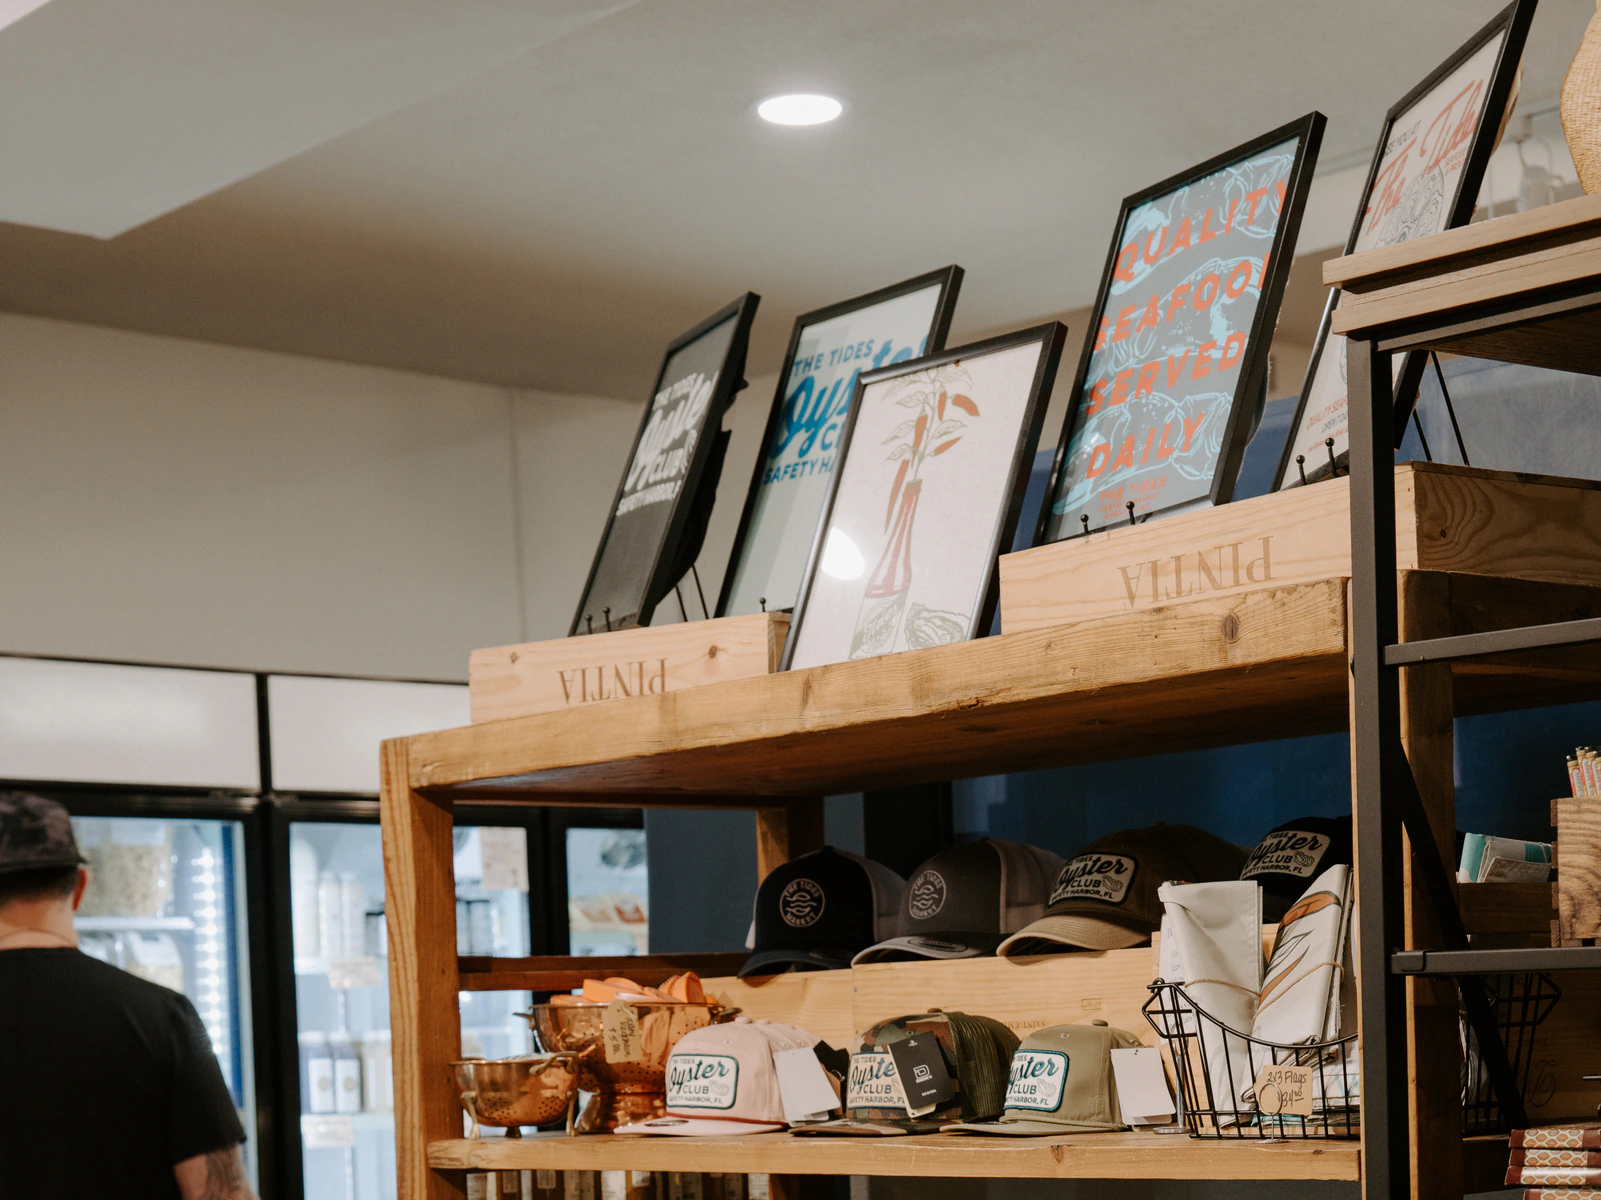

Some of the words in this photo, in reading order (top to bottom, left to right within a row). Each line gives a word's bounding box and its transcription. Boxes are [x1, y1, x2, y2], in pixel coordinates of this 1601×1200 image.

[793, 352, 825, 377] THE
[829, 339, 875, 367] TIDES
[1085, 331, 1247, 416] SERVED
[1085, 412, 1207, 479] DAILY
[764, 457, 819, 484] SAFETY
[1100, 486, 1145, 504] THE
[1129, 475, 1168, 496] TIDES
[1116, 536, 1276, 609] PINTIA
[557, 658, 669, 704] PINTIA
[1261, 854, 1294, 865] CLUB
[1070, 878, 1102, 889] CLUB
[1103, 891, 1114, 899] FL
[669, 1060, 730, 1094] Oyster
[850, 1057, 897, 1094] Oyste
[863, 1084, 892, 1094] CLUB
[1008, 1056, 1059, 1095] yster
[1013, 1083, 1037, 1095] CLUB
[1284, 1070, 1308, 1090] Flags
[682, 1085, 710, 1095] CLUB
[1040, 1098, 1049, 1106] FL
